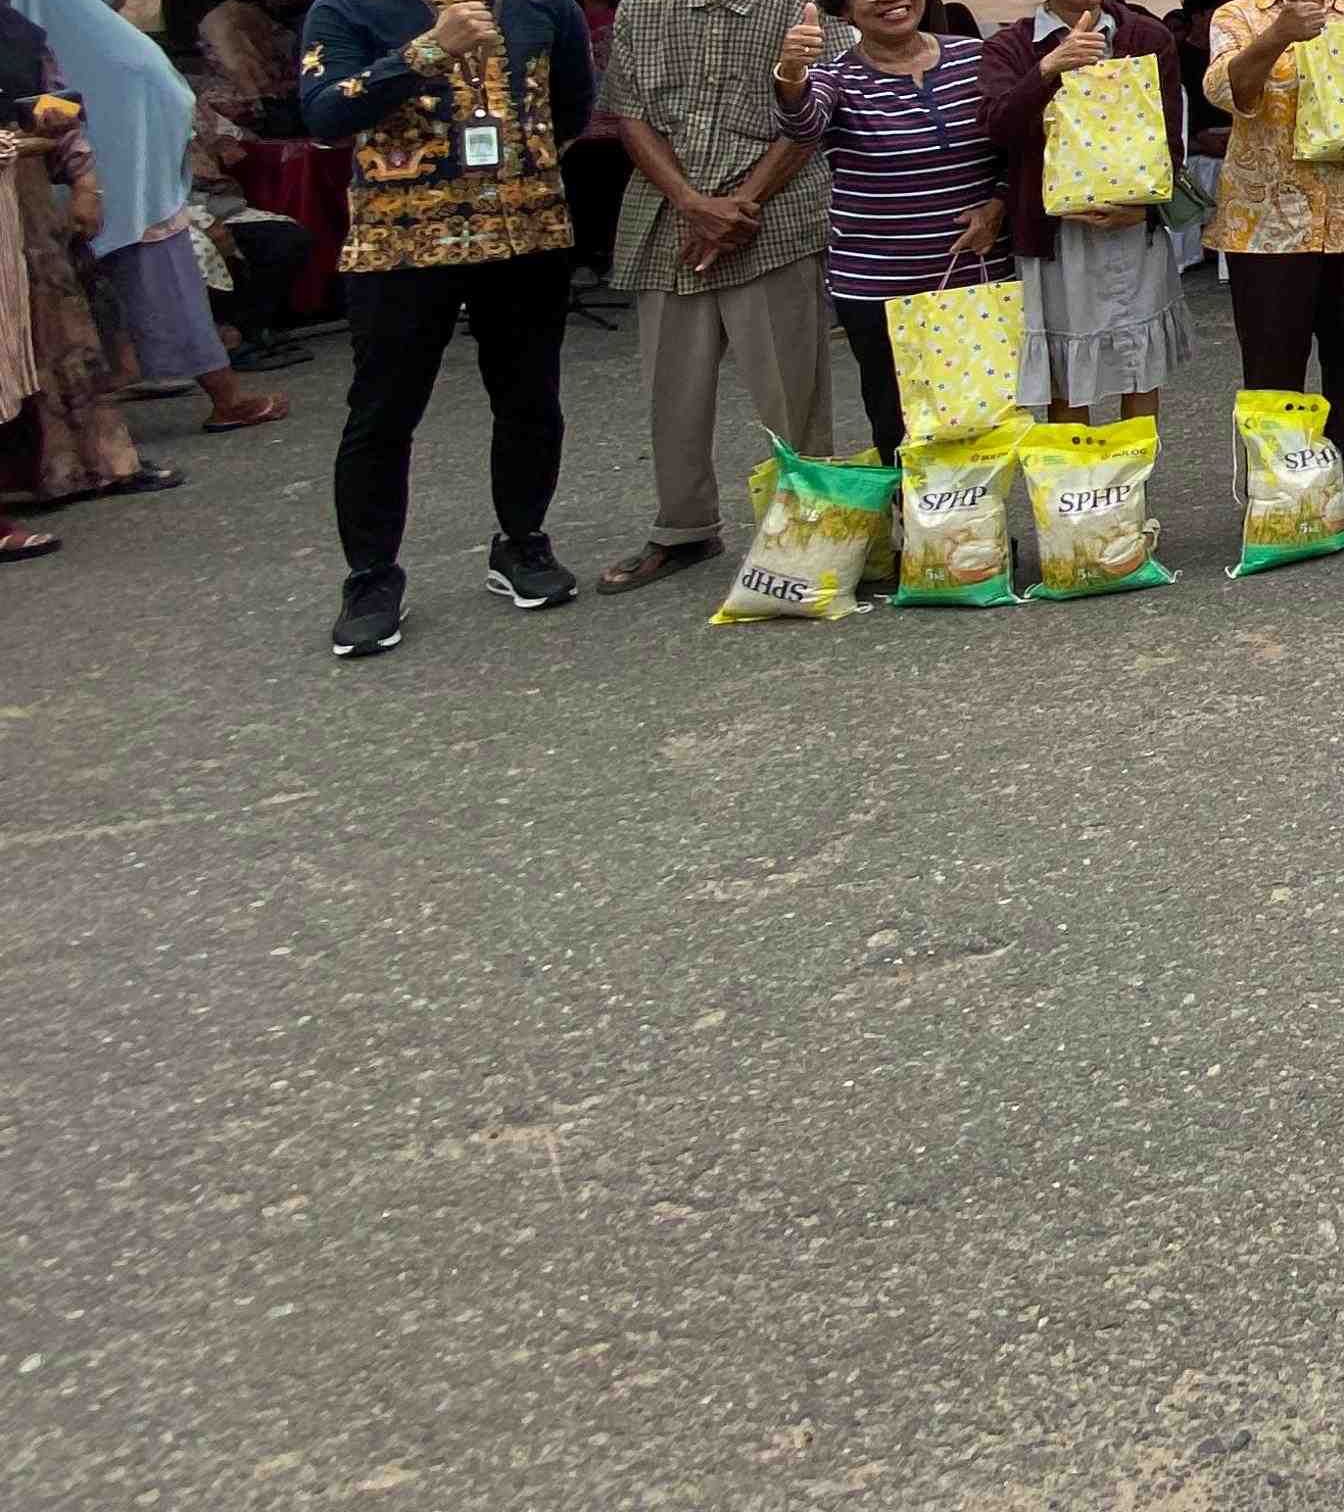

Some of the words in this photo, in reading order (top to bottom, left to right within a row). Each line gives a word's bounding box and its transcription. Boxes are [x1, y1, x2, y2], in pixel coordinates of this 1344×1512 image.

[919, 486, 988, 511] SPHP
[1058, 485, 1130, 513] SPHP
[742, 567, 808, 602] SPHP
